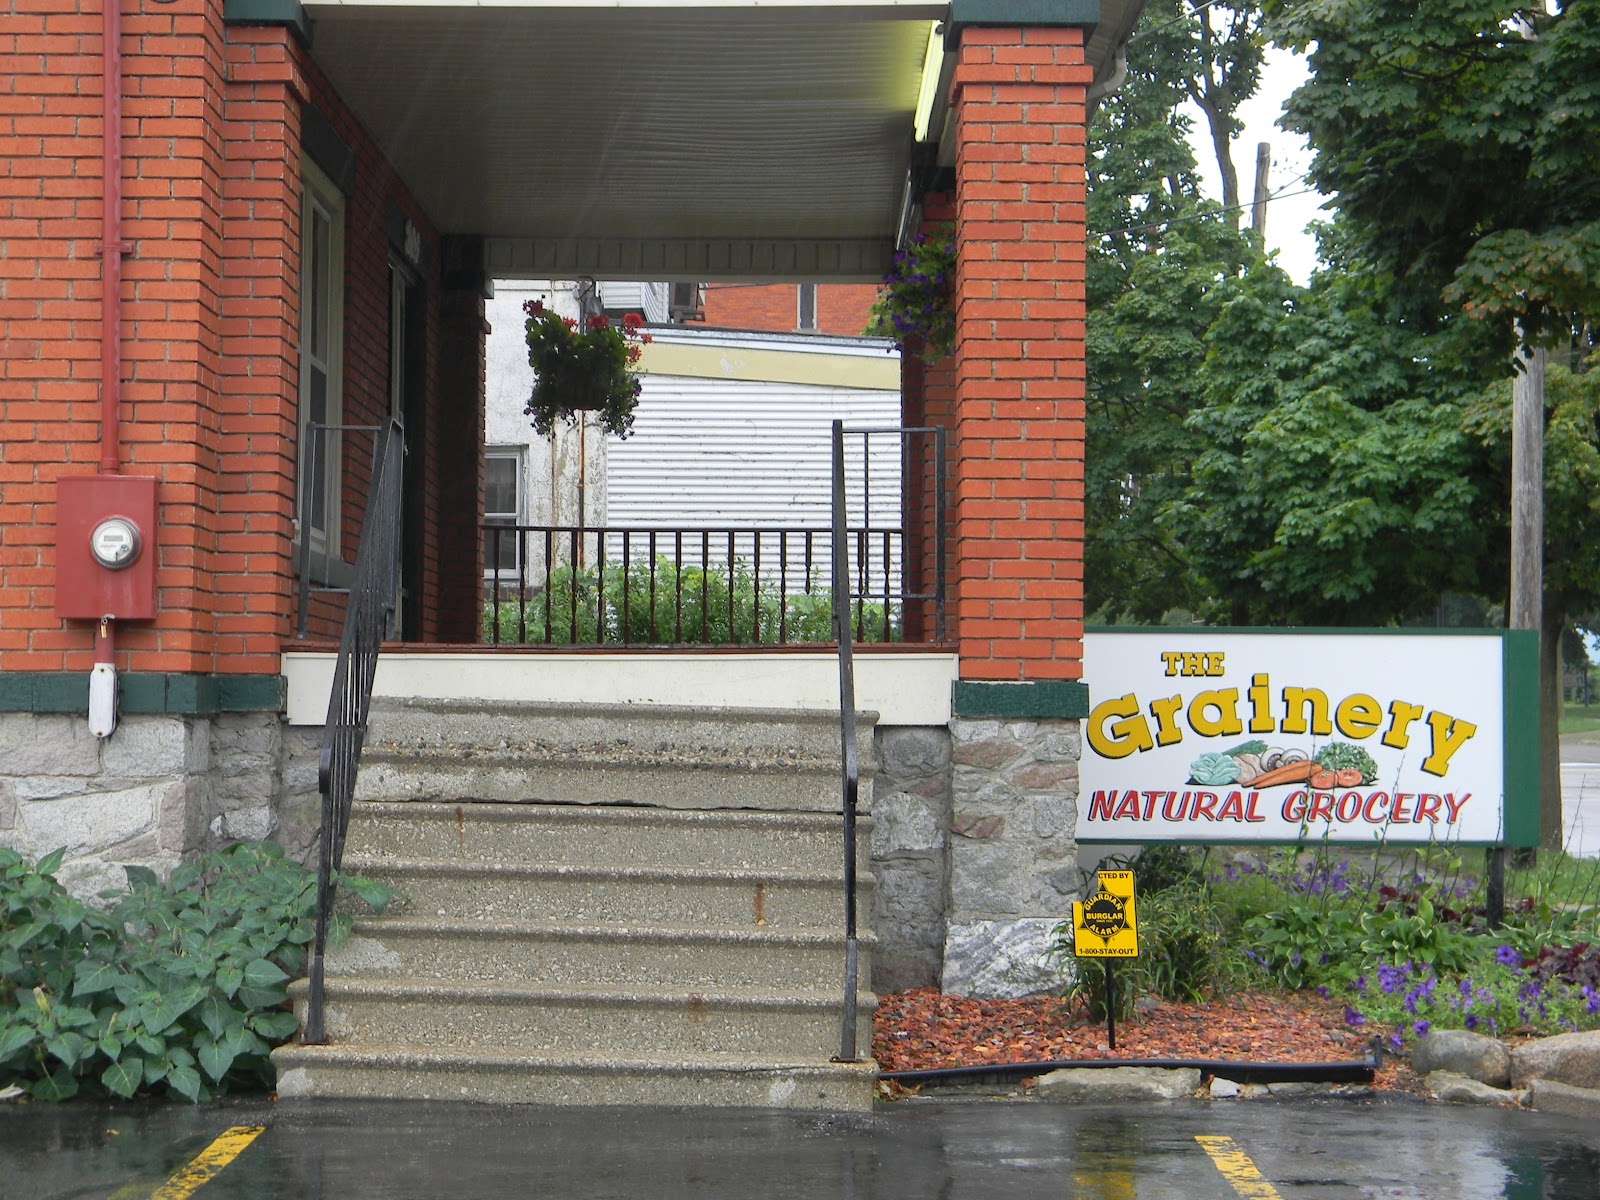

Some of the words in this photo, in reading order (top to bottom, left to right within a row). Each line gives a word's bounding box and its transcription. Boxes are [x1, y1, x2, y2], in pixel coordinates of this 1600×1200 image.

[1161, 651, 1225, 677] THE
[1086, 673, 1477, 777] Grainery
[1088, 789, 1266, 822] NATURAL
[1281, 791, 1472, 824] GROCERY
[1084, 893, 1123, 911] GUARDIAN
[1086, 912, 1123, 920] BURGLAR
[1089, 924, 1120, 936] ALARM
[1079, 947, 1134, 955] 1-800-STAY-OUT
